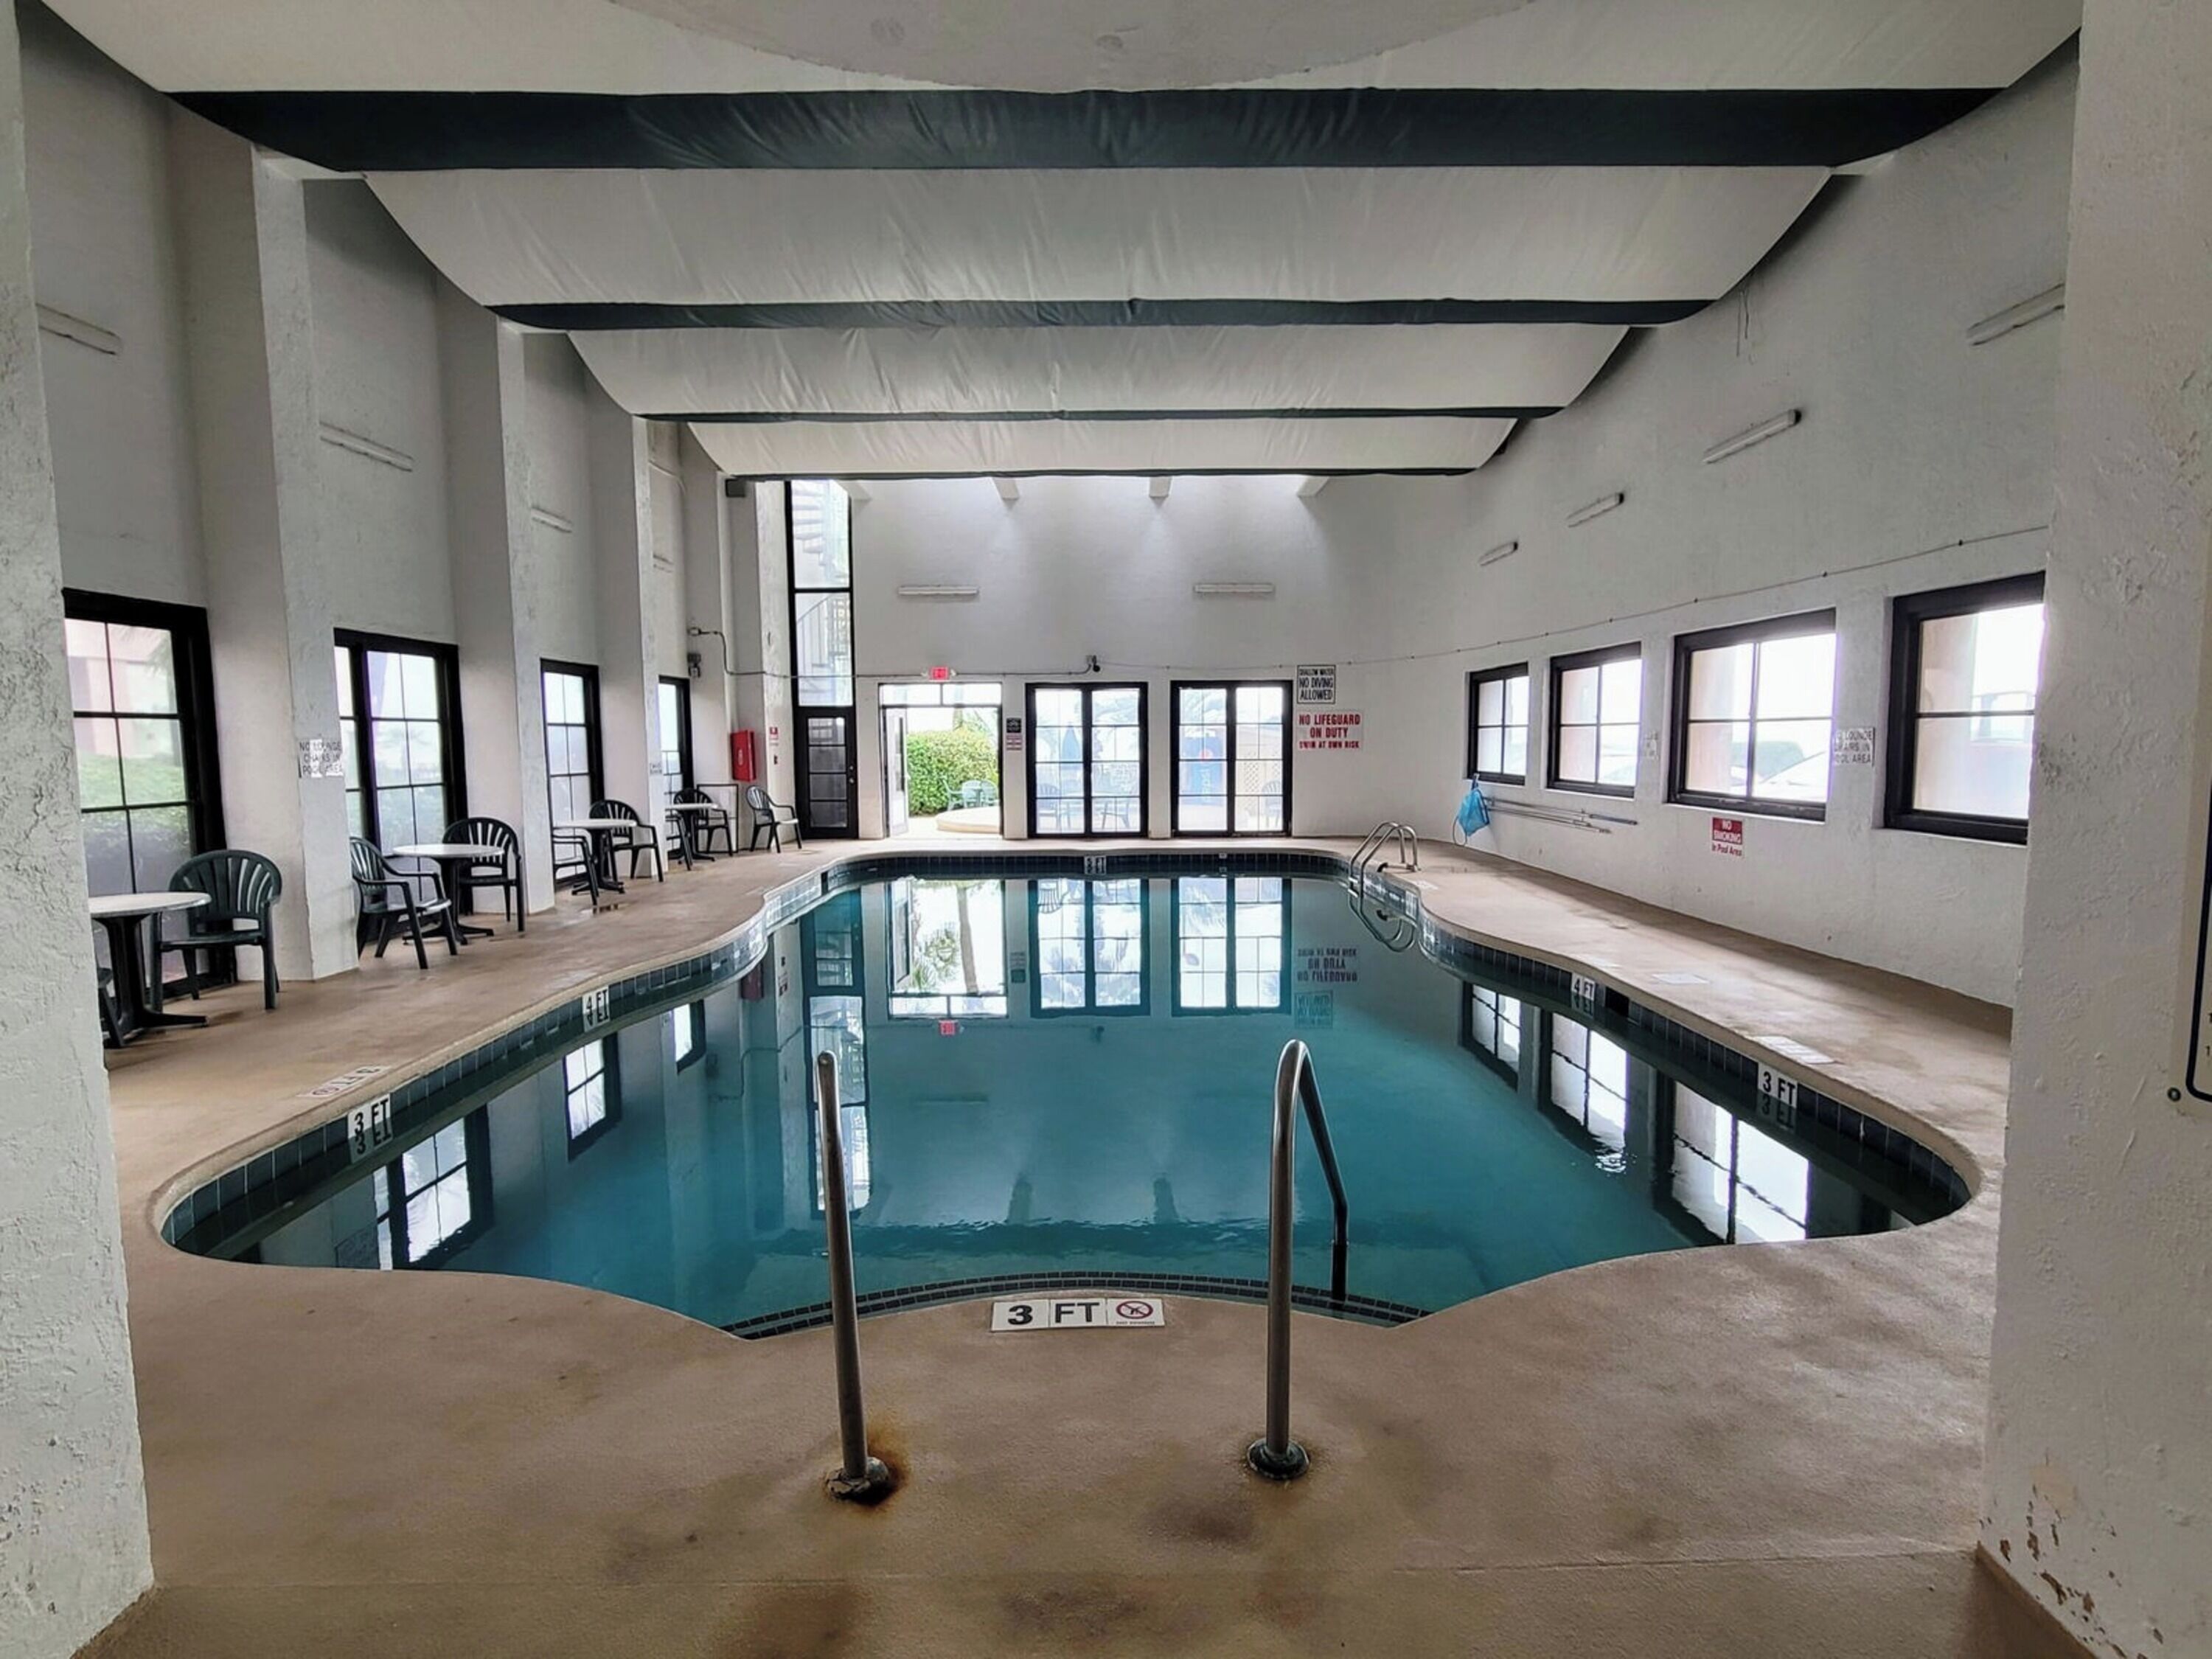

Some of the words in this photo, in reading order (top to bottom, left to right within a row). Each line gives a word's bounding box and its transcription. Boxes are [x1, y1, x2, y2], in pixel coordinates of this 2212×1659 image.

[1299, 677, 1310, 688] NO
[1311, 677, 1334, 688] DIVING
[1299, 689, 1333, 700] ALLOWED
[1299, 714, 1311, 725] NO
[1314, 714, 1360, 725] LIFEGUARD
[1310, 727, 1322, 739] ON
[1326, 727, 1348, 739] DUTY
[299, 742, 310, 751] NO
[1574, 978, 1580, 994] 4
[1584, 981, 1593, 997] FT
[586, 995, 593, 1014] 4
[597, 990, 608, 1009] FT
[1762, 1071, 1772, 1093] 3
[1777, 1077, 1796, 1105] FT
[354, 1112, 364, 1135] 3
[371, 1099, 389, 1125] FT
[1007, 1304, 1033, 1326] 3
[1054, 1301, 1099, 1324] FT
